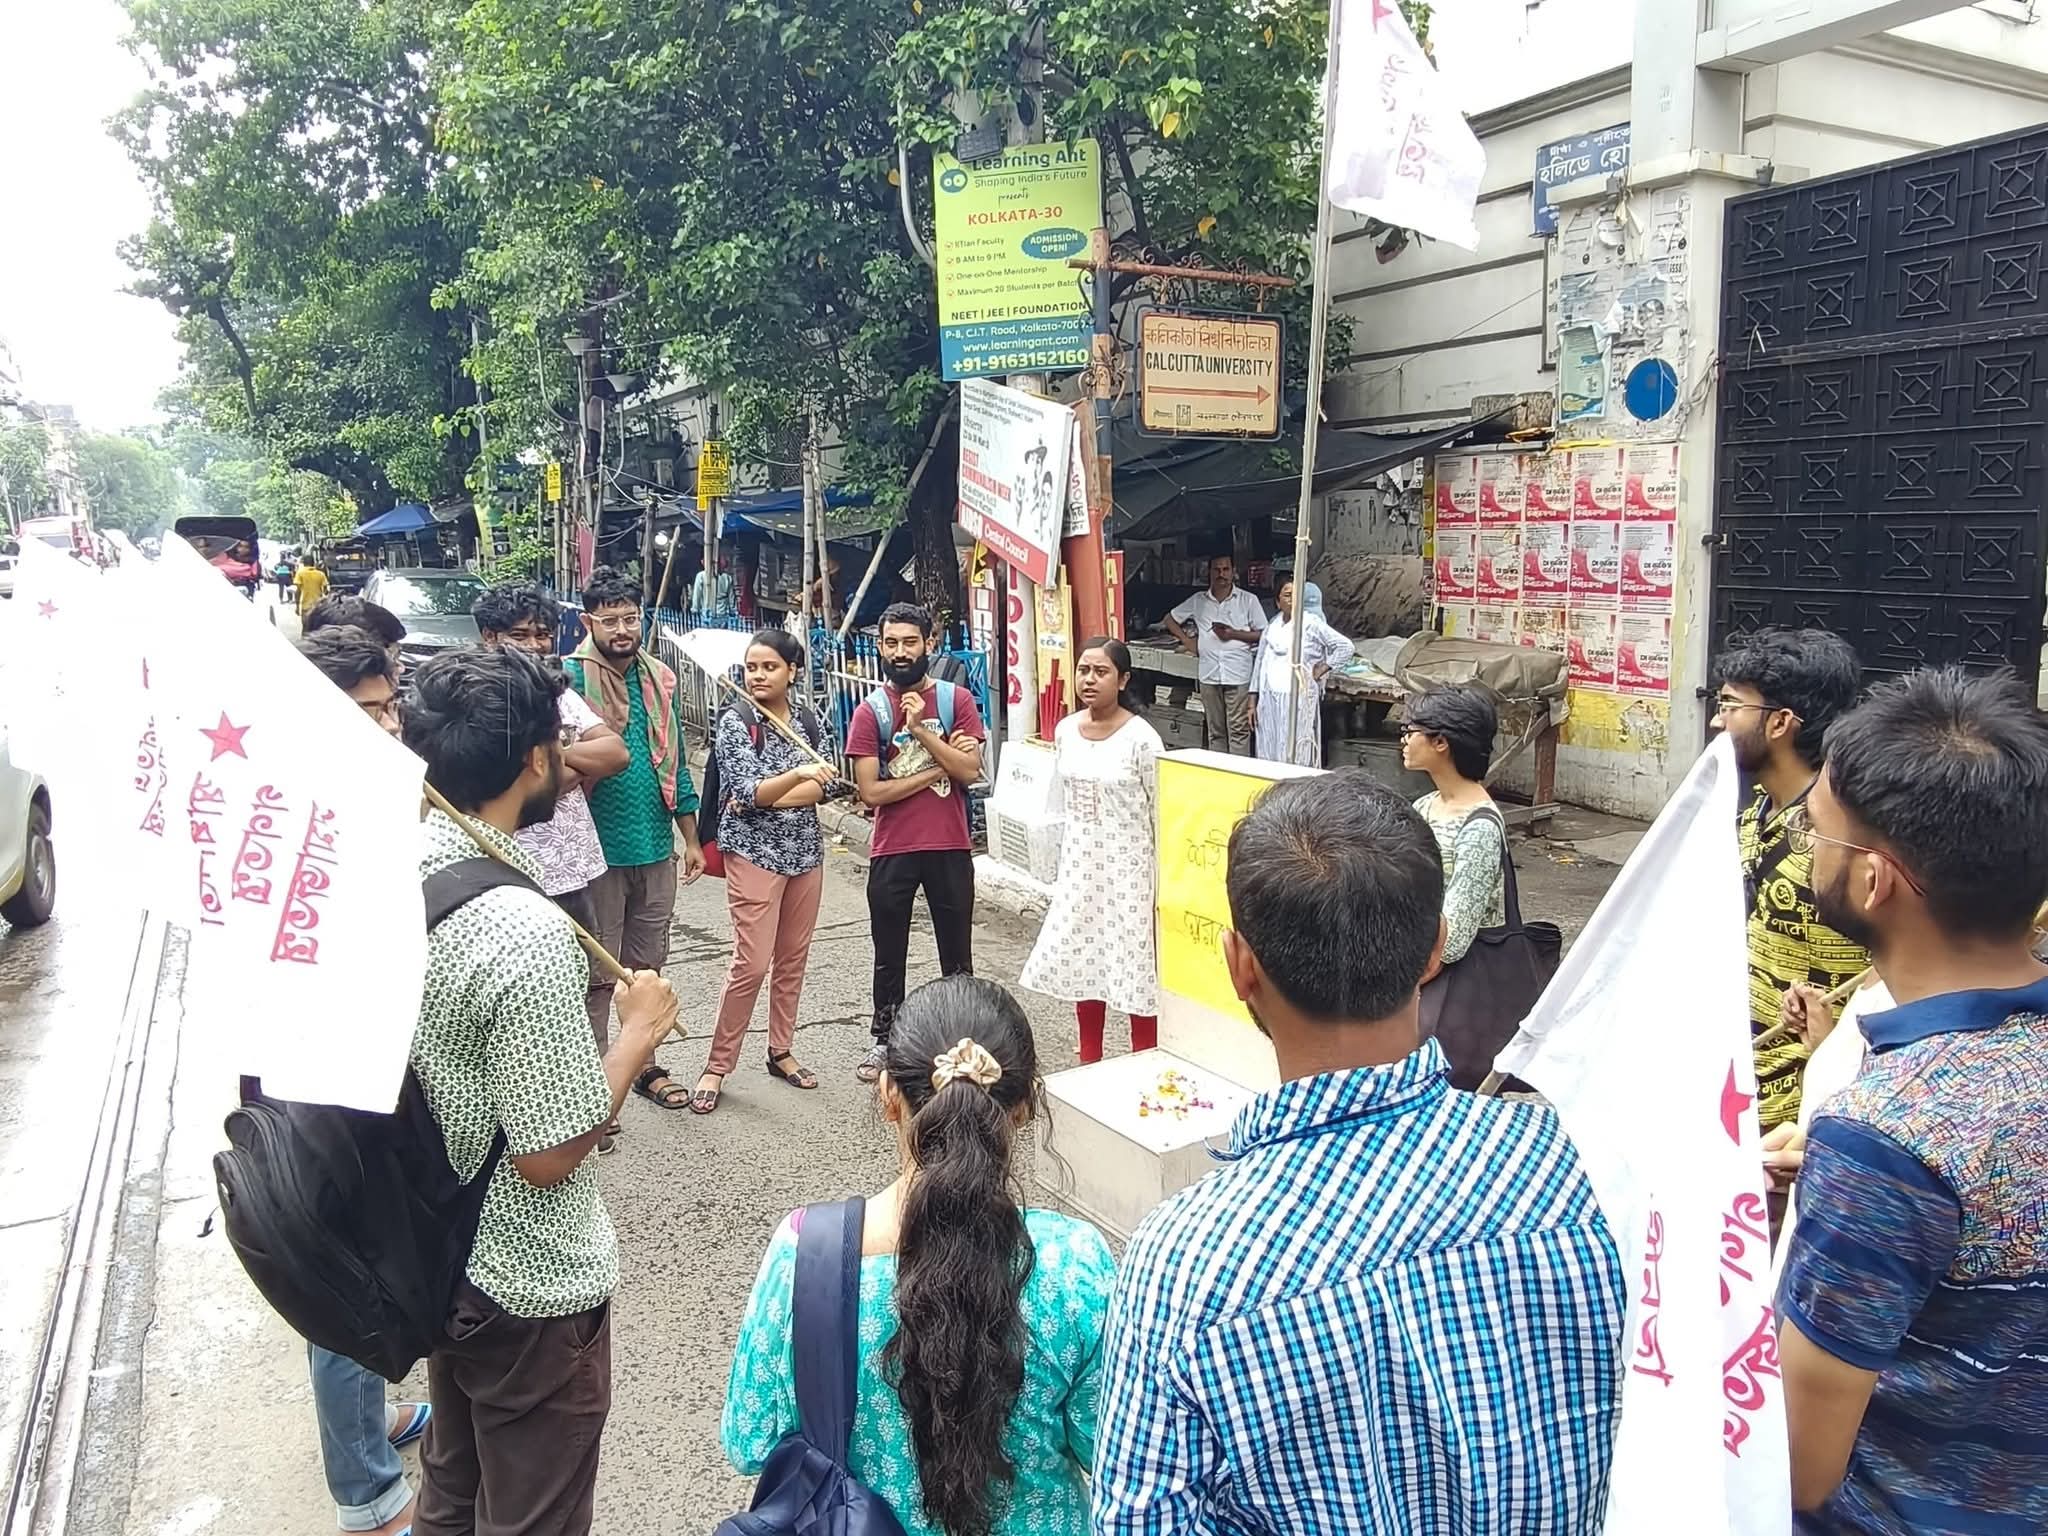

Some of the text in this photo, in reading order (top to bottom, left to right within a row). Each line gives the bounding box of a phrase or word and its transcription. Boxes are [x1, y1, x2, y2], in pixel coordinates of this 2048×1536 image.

[973, 149, 1086, 171] Learning Ant
[1539, 142, 1631, 184] হলিডে হো
[975, 170, 1087, 188] Shaping India's Future
[998, 187, 1029, 207] presents
[968, 206, 1063, 225] KOLKATA-30
[976, 237, 1005, 248] Faculty
[1030, 232, 1078, 246] ADMISSION
[1004, 266, 1047, 278] Mentorship
[957, 286, 993, 297] Maximum
[1006, 282, 1041, 292] Students
[1042, 281, 1055, 291] per
[951, 310, 979, 321] NEET
[987, 306, 1005, 317] JEE
[1013, 302, 1087, 315] FOUNDATION
[962, 335, 1079, 352] www.learningant.com
[1146, 322, 1272, 351] কলিকাতা বিশ্ববিদ্যালয়
[952, 349, 1089, 372] +91-9163152160
[1146, 352, 1273, 377] CALCUTTA UNIVERSITY
